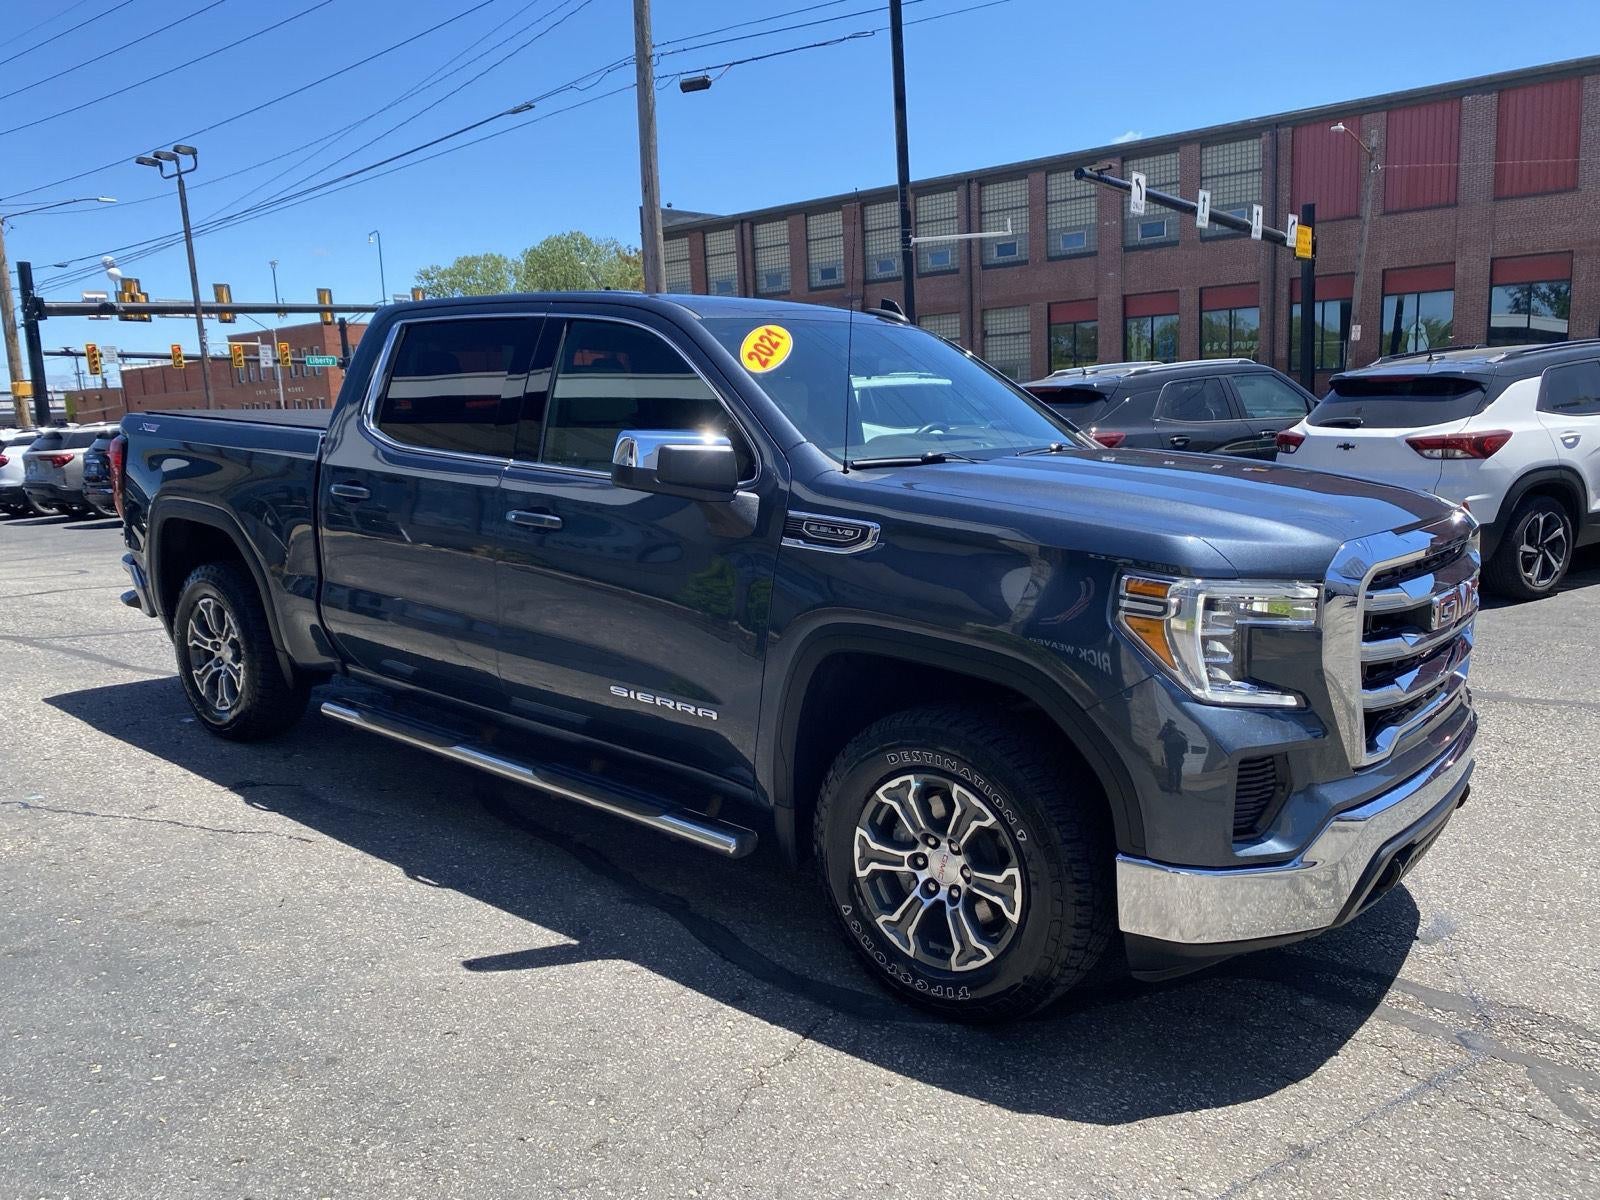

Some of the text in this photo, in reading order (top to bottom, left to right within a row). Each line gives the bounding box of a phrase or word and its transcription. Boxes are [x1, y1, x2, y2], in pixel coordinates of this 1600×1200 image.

[309, 357, 333, 366] Liberty
[747, 328, 784, 368] 2021
[1431, 577, 1480, 630] GMC
[609, 685, 718, 721] SIERRA
[886, 750, 1018, 826] DESTINATION
[938, 854, 949, 881] GMC
